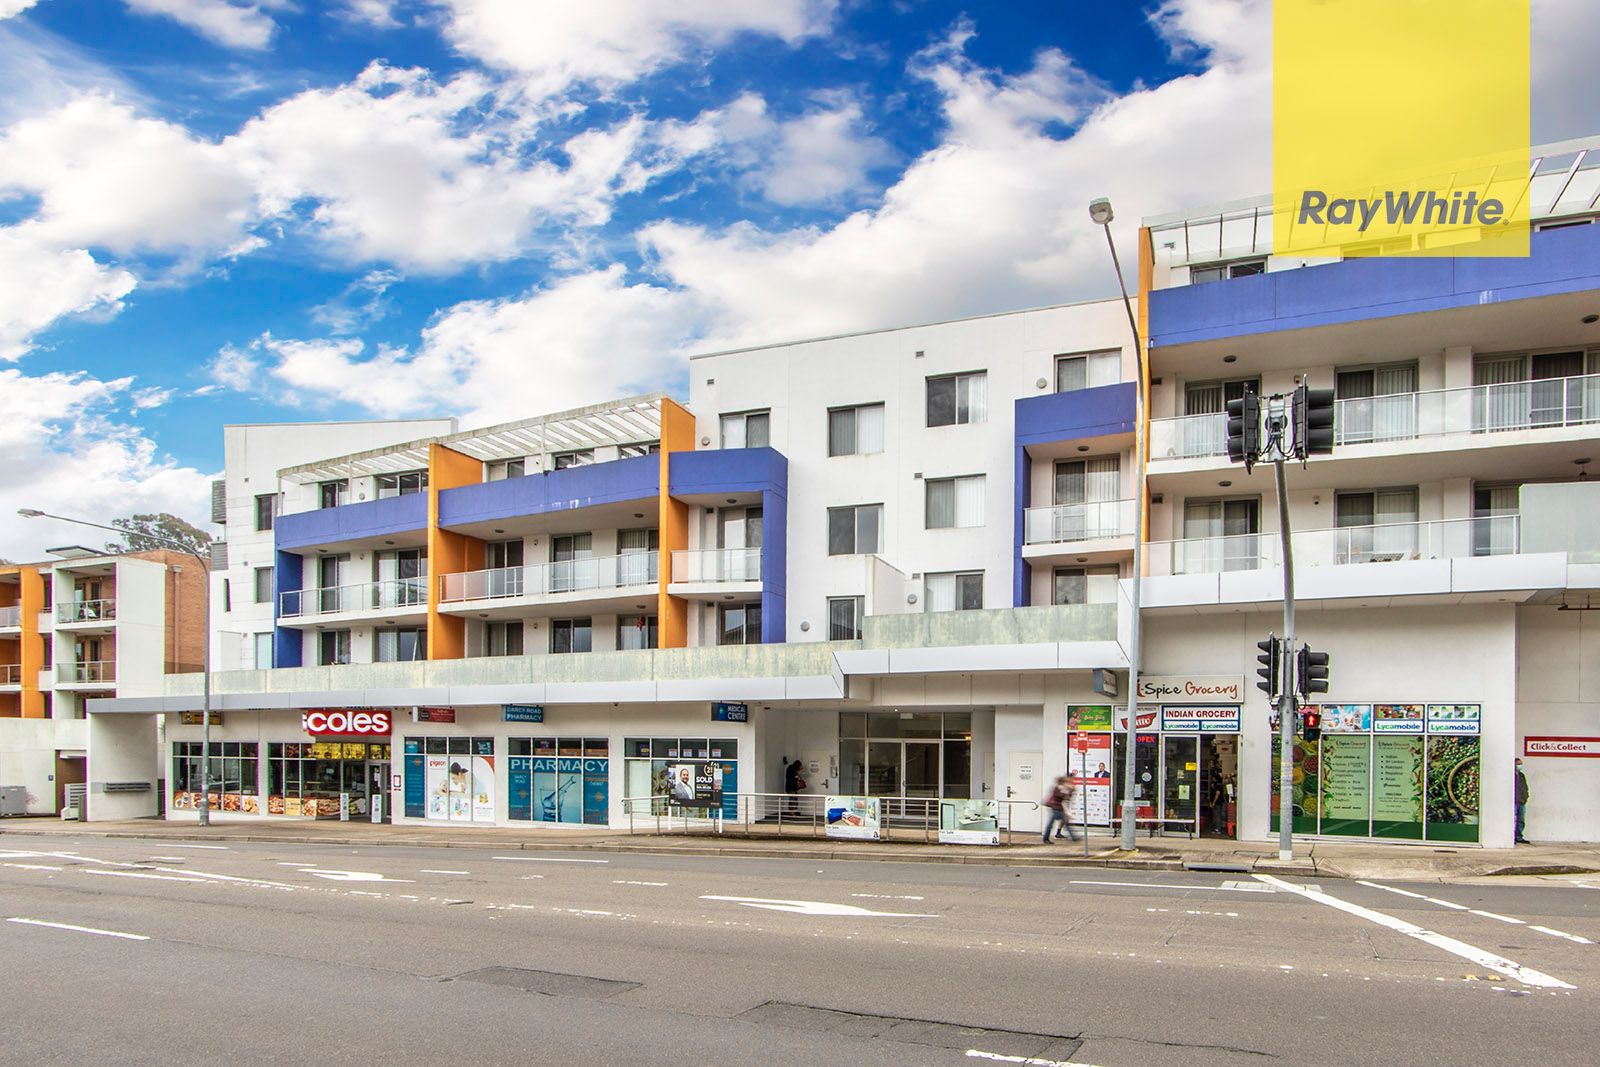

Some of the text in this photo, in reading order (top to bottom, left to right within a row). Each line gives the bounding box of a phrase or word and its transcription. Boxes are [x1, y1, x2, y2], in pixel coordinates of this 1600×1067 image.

[1185, 681, 1238, 699] Grocery
[506, 713, 541, 721] PHARMACY
[727, 712, 746, 720] CENTRE
[1196, 710, 1237, 718] GROCERY
[308, 711, 389, 732] coles
[1376, 723, 1421, 731] Lycamobile
[1431, 724, 1477, 732] Lycamobile
[1530, 743, 1586, 751] Click&Collect
[511, 759, 608, 772] PHARMACY
